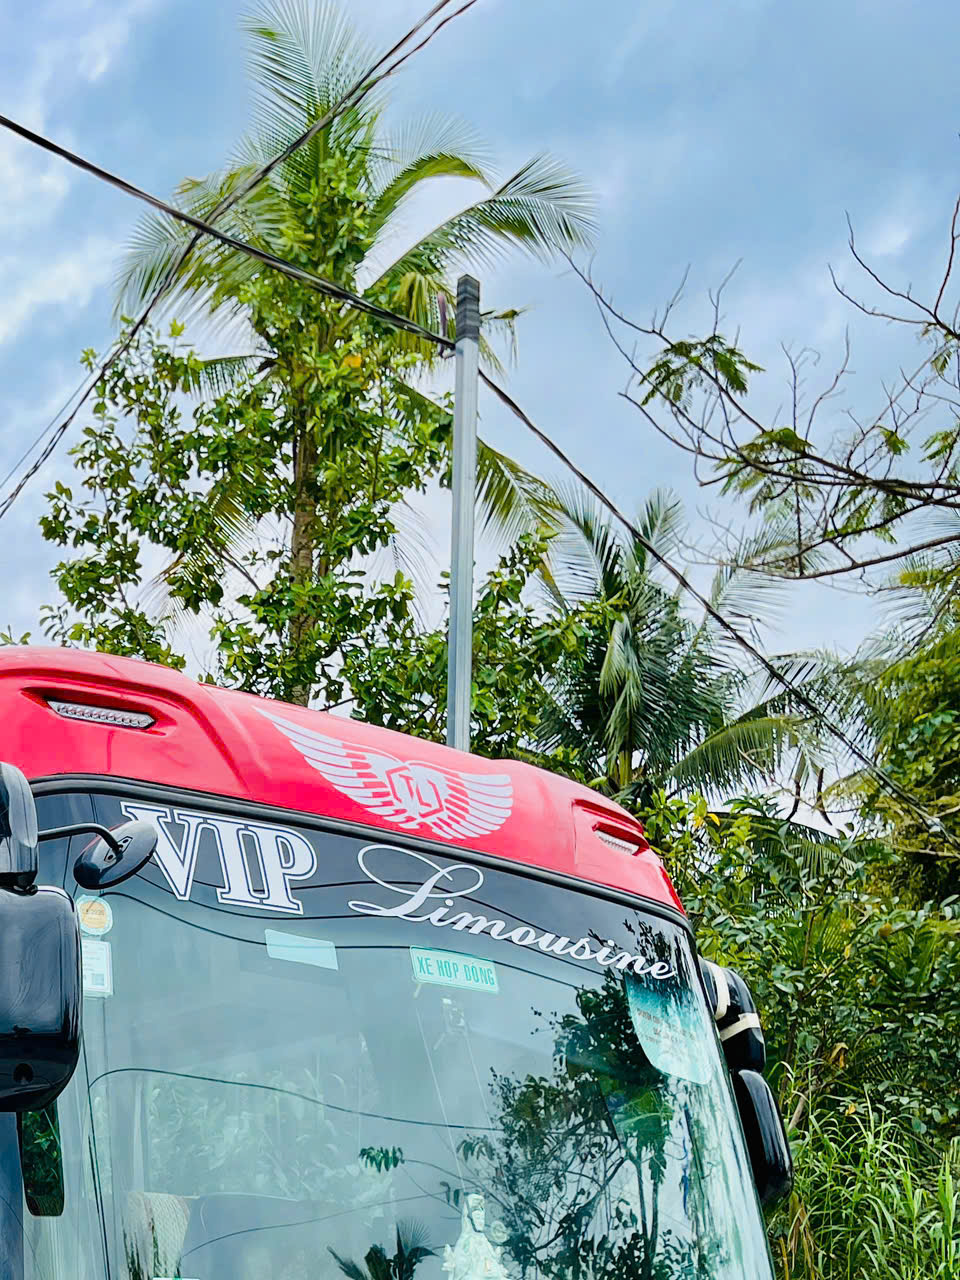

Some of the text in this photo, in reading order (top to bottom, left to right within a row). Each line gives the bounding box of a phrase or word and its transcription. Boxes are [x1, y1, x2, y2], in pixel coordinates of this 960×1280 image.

[120, 800, 678, 981] VIP Limousine
[416, 955, 434, 976] XE
